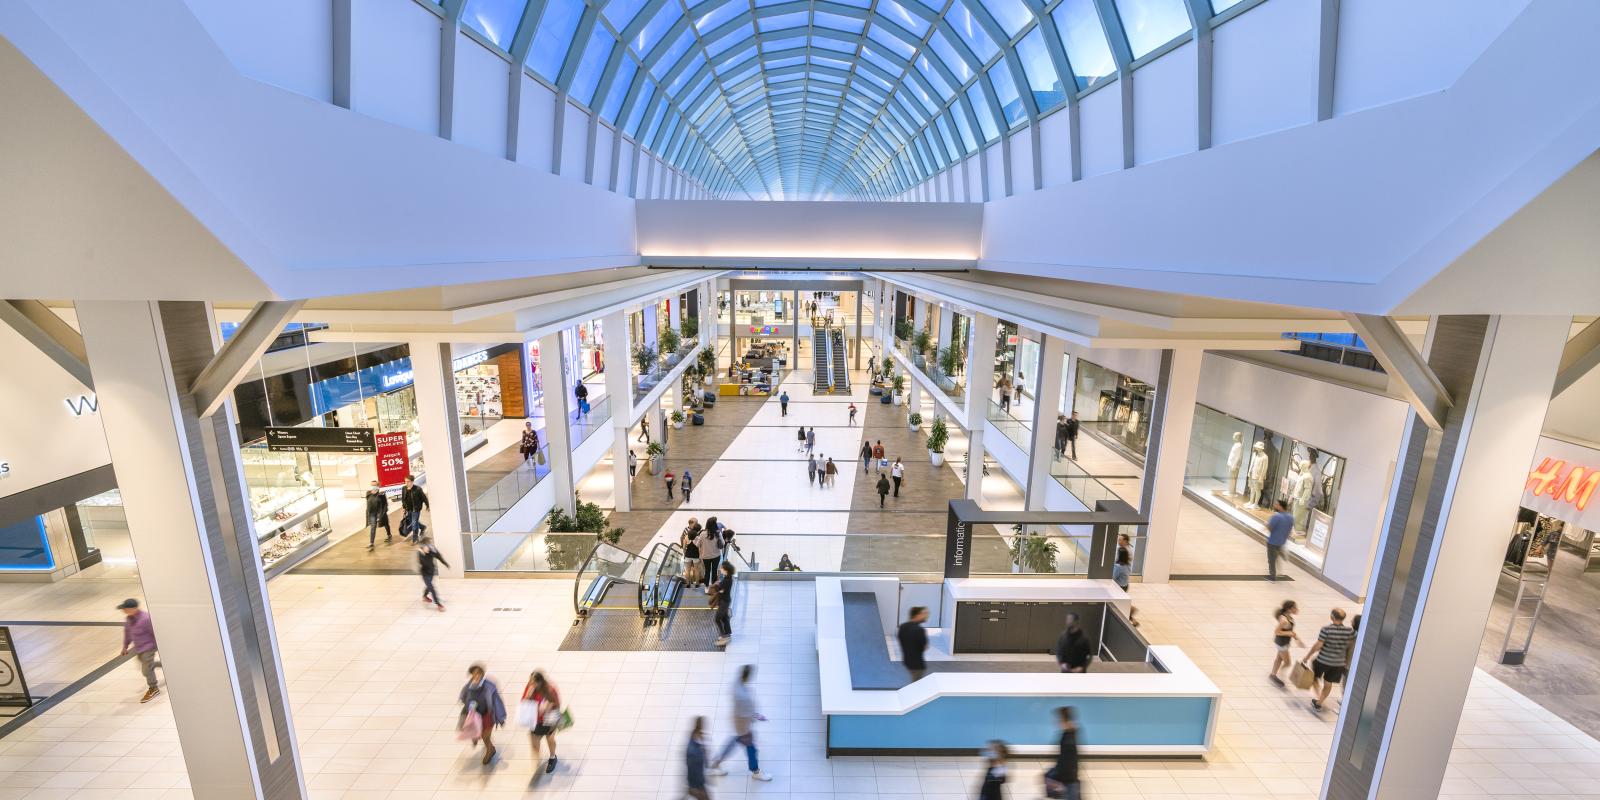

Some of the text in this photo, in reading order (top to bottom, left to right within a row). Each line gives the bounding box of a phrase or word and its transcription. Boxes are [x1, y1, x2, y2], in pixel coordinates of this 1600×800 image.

[377, 435, 404, 444] SUPER
[381, 457, 404, 467] 50%
[1526, 456, 1600, 511] H&M
